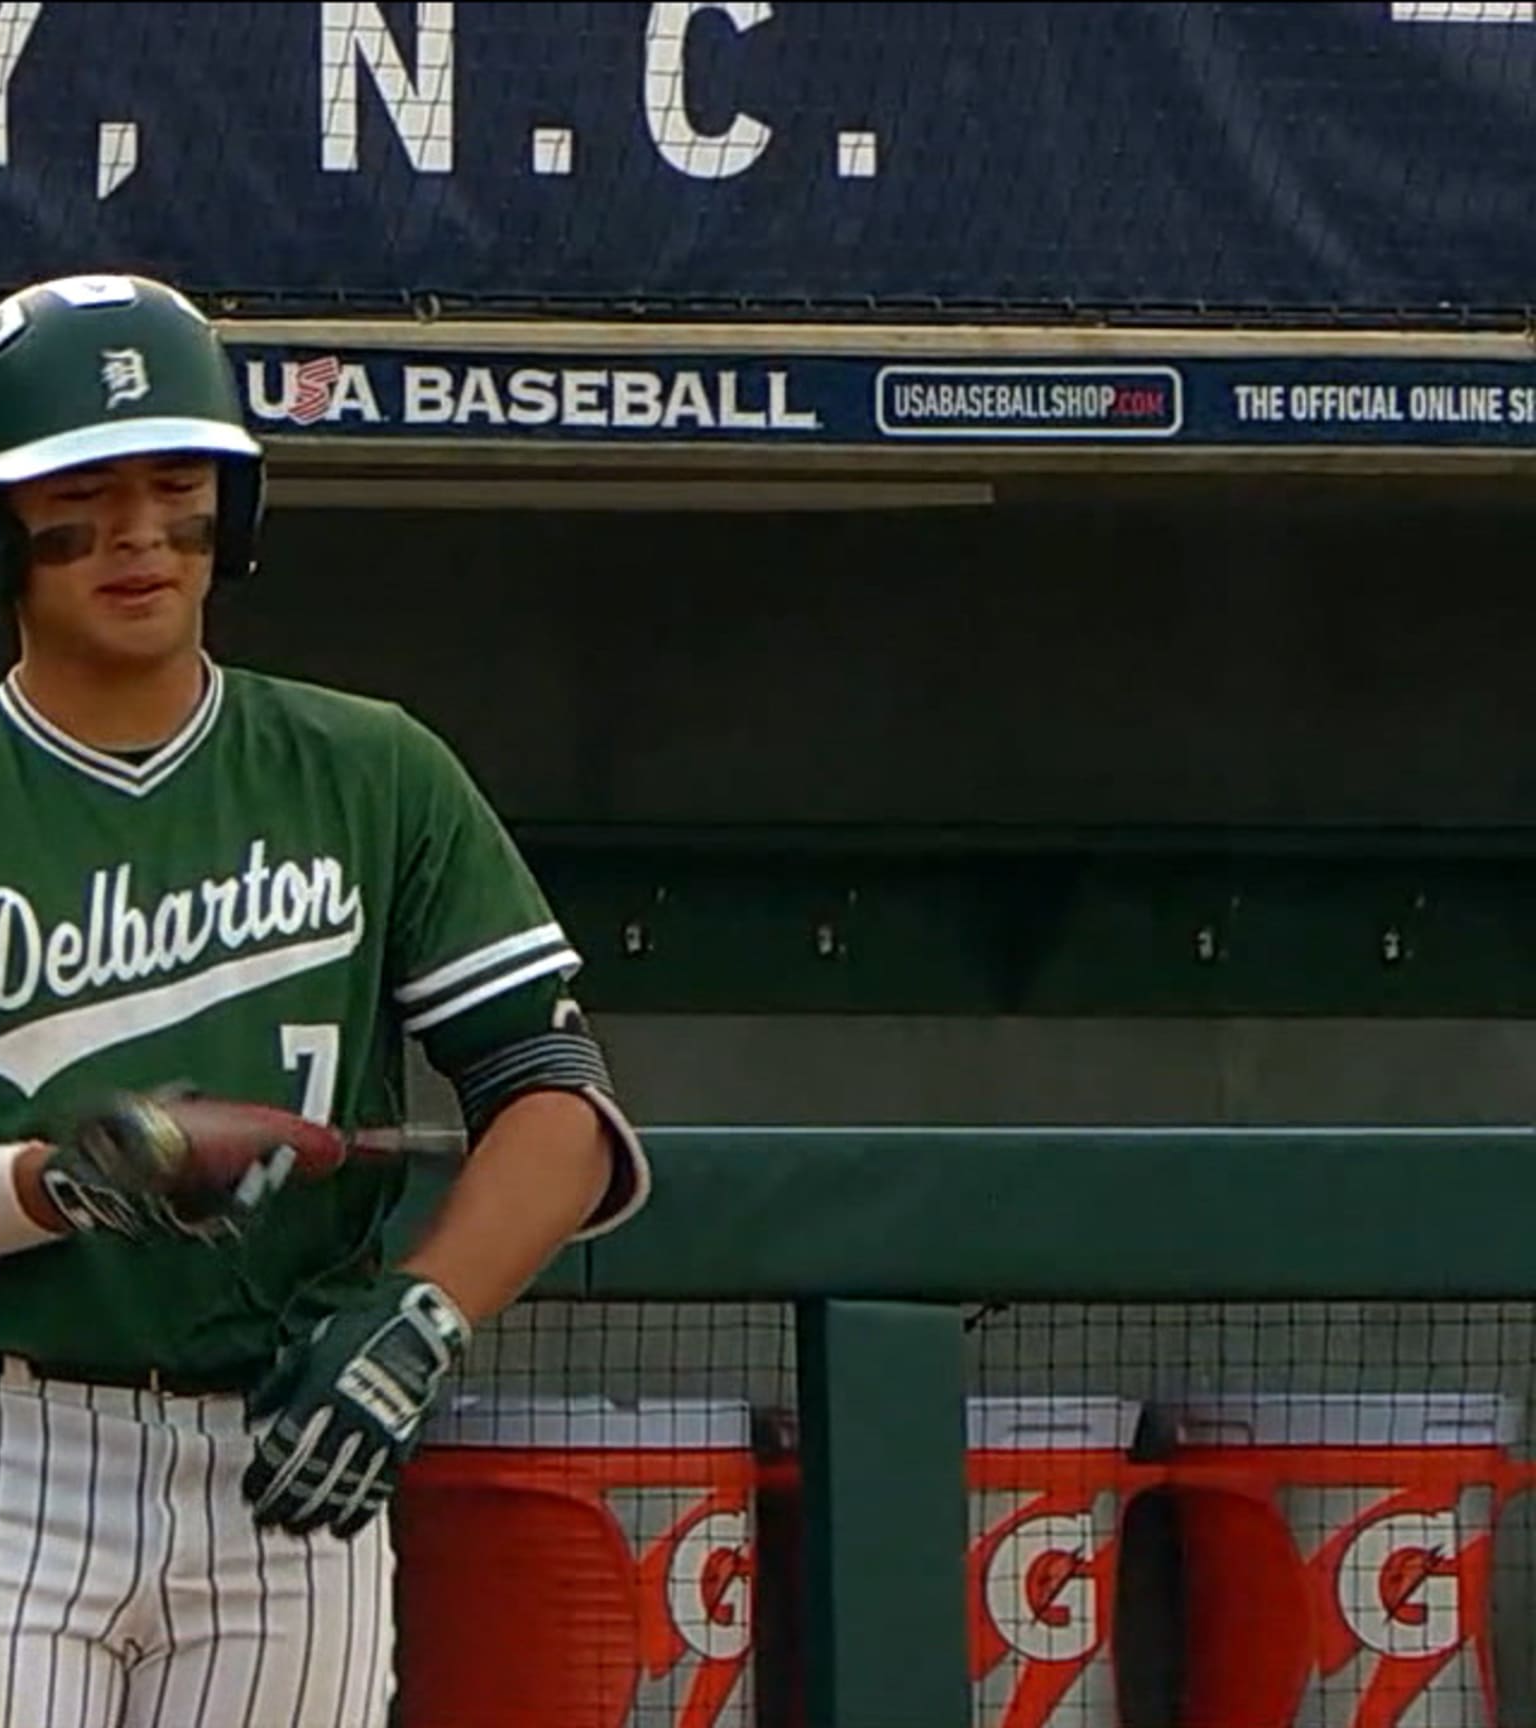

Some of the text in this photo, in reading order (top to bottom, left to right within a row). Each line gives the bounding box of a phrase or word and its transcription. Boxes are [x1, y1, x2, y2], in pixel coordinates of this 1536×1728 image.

[320, 1, 877, 179] N.C.
[246, 356, 818, 430] USA BASEBALL
[894, 384, 1165, 420] USABASEBALLSHOP.COM
[1234, 384, 1284, 421] THE
[1290, 385, 1405, 421] OFFICIAL
[1409, 386, 1504, 422] ONLINE
[280, 1023, 339, 1126] 7
